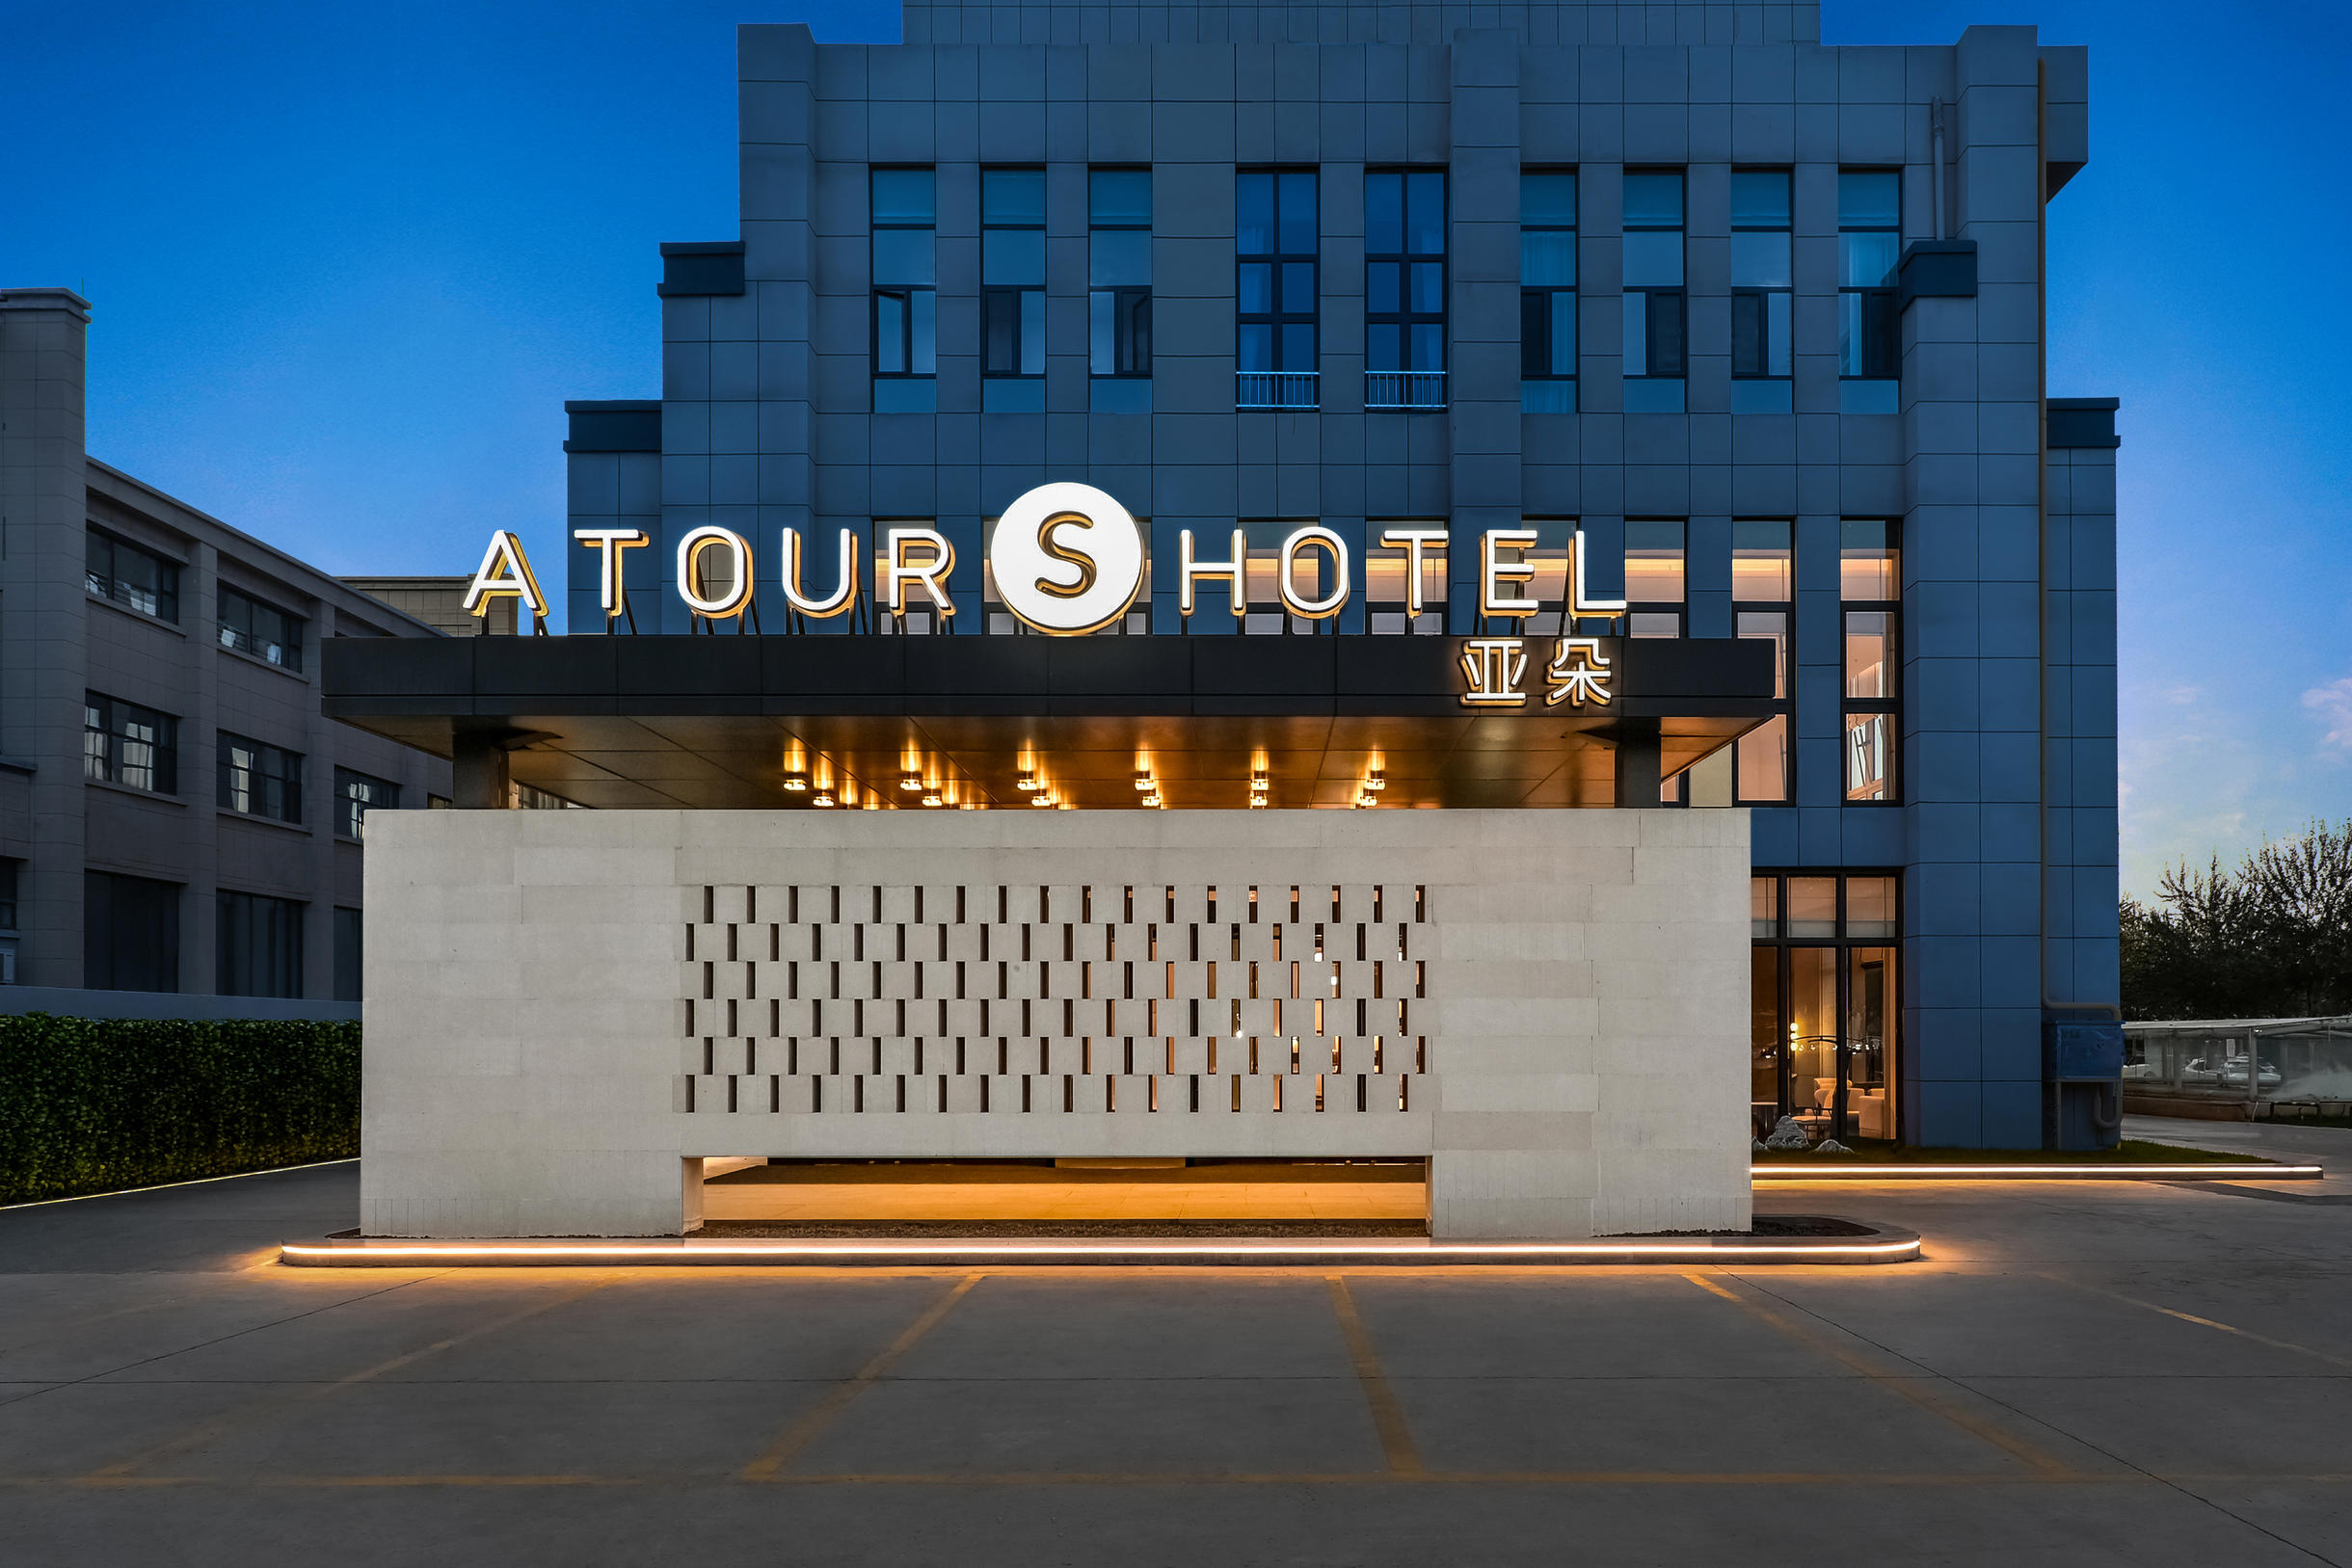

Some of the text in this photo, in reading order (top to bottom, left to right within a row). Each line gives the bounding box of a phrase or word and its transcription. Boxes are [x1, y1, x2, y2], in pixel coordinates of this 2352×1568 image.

[462, 510, 1628, 619] ATOUR S HOTEL
[1459, 637, 1613, 707] 亚朵
